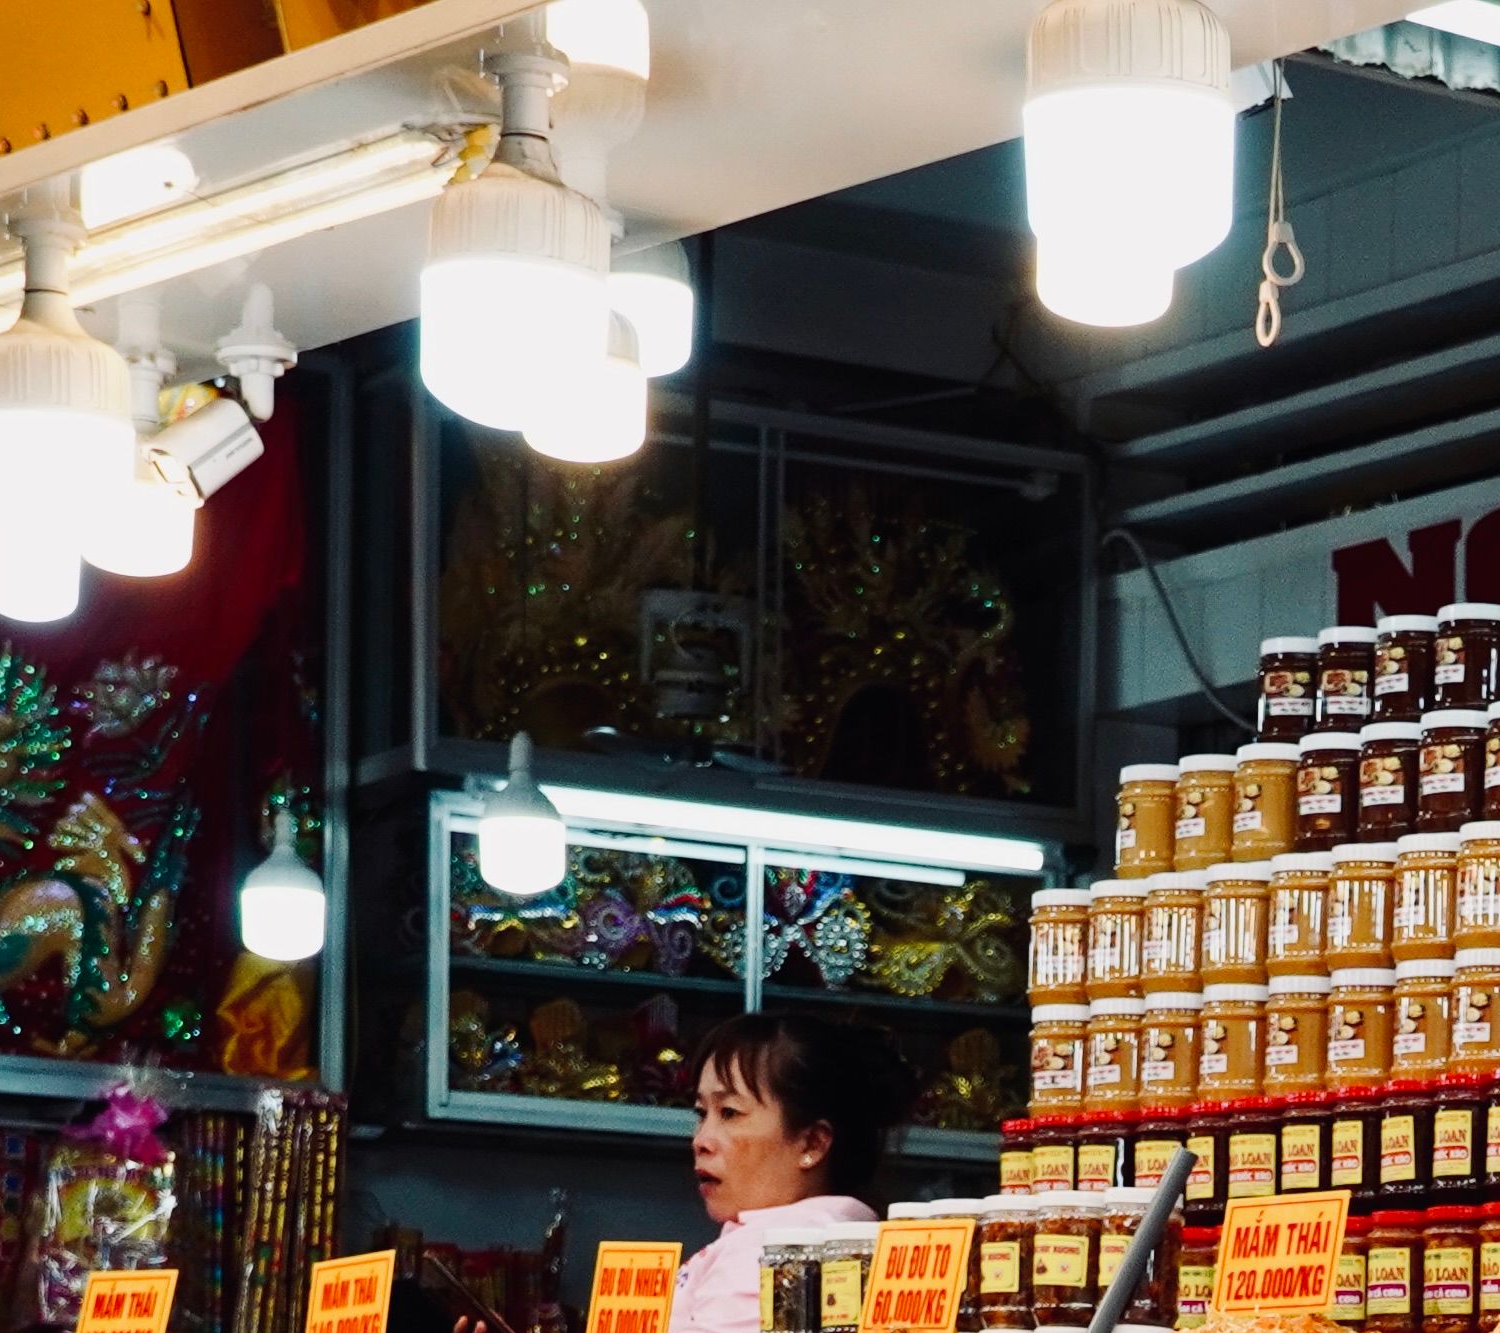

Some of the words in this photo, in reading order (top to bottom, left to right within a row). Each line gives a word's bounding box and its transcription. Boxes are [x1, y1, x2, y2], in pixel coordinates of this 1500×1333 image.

[1231, 1213, 1280, 1259] MẮM
[1284, 1209, 1333, 1257] THÁI
[932, 1243, 952, 1279] TO
[1226, 1262, 1328, 1303] 120.000/KG
[871, 1288, 947, 1326] 60.000/KG
